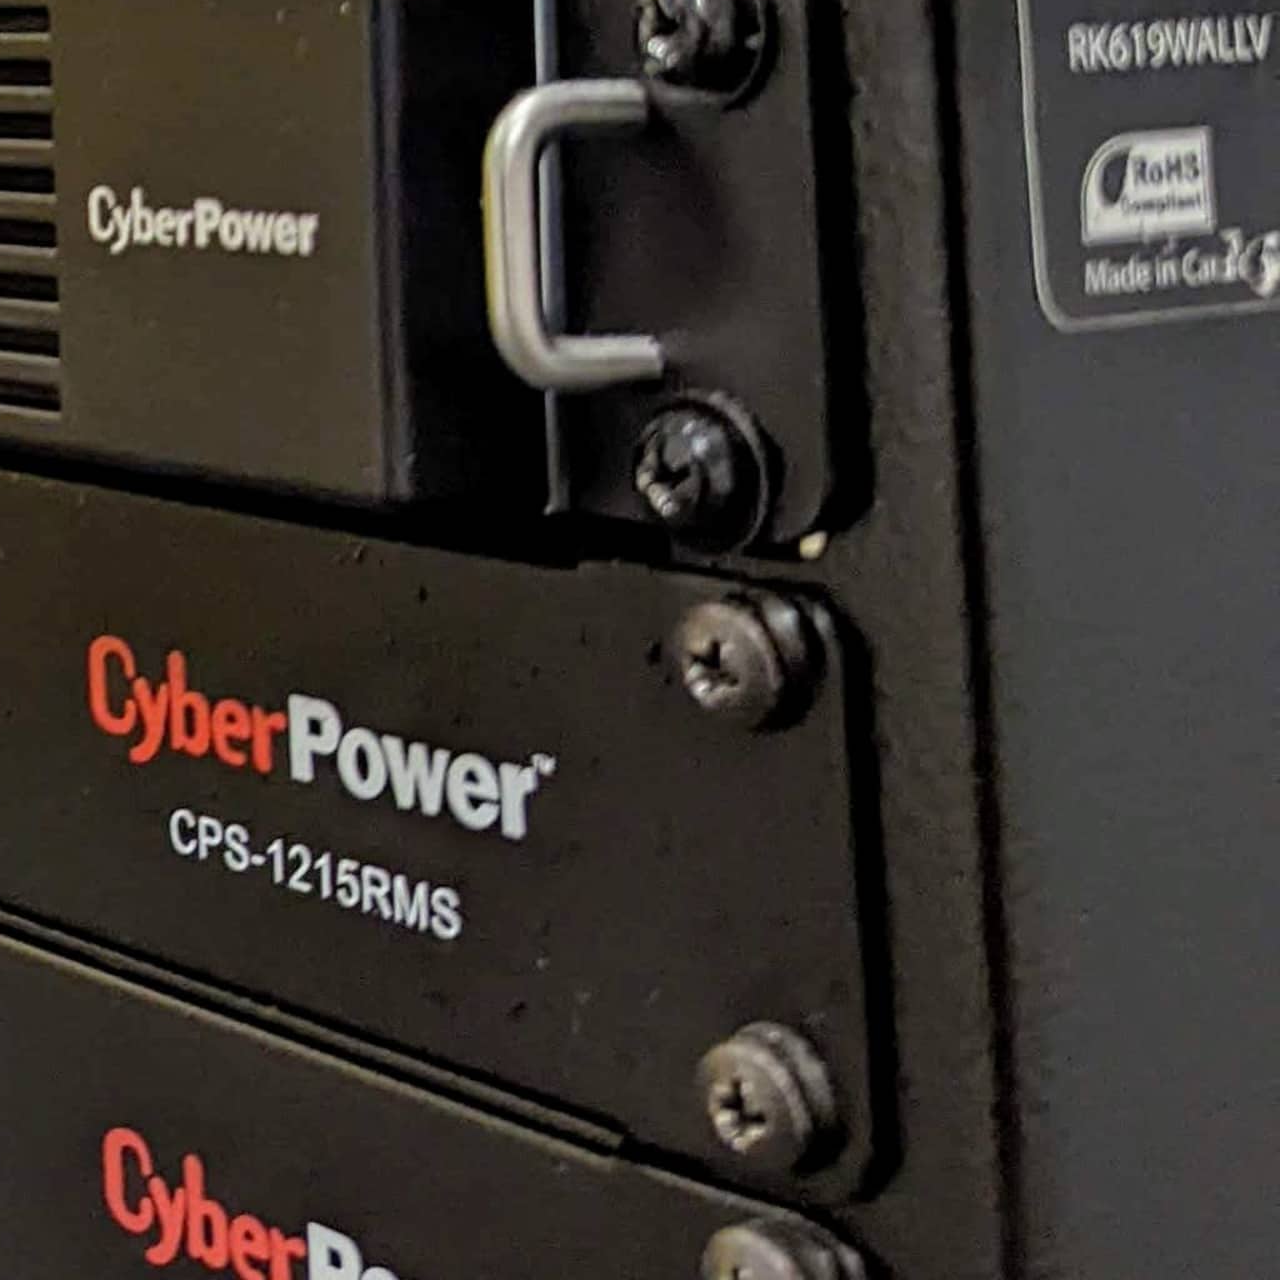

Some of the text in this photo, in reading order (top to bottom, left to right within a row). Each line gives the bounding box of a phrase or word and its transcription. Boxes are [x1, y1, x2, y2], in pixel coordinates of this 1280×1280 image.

[1067, 13, 1272, 73] RK619WALLV
[1131, 151, 1200, 186] RoHS
[88, 185, 319, 256] CyberPower
[1084, 252, 1151, 295] Made
[1155, 252, 1178, 288] in
[169, 808, 463, 940] CPS-1215RMS
